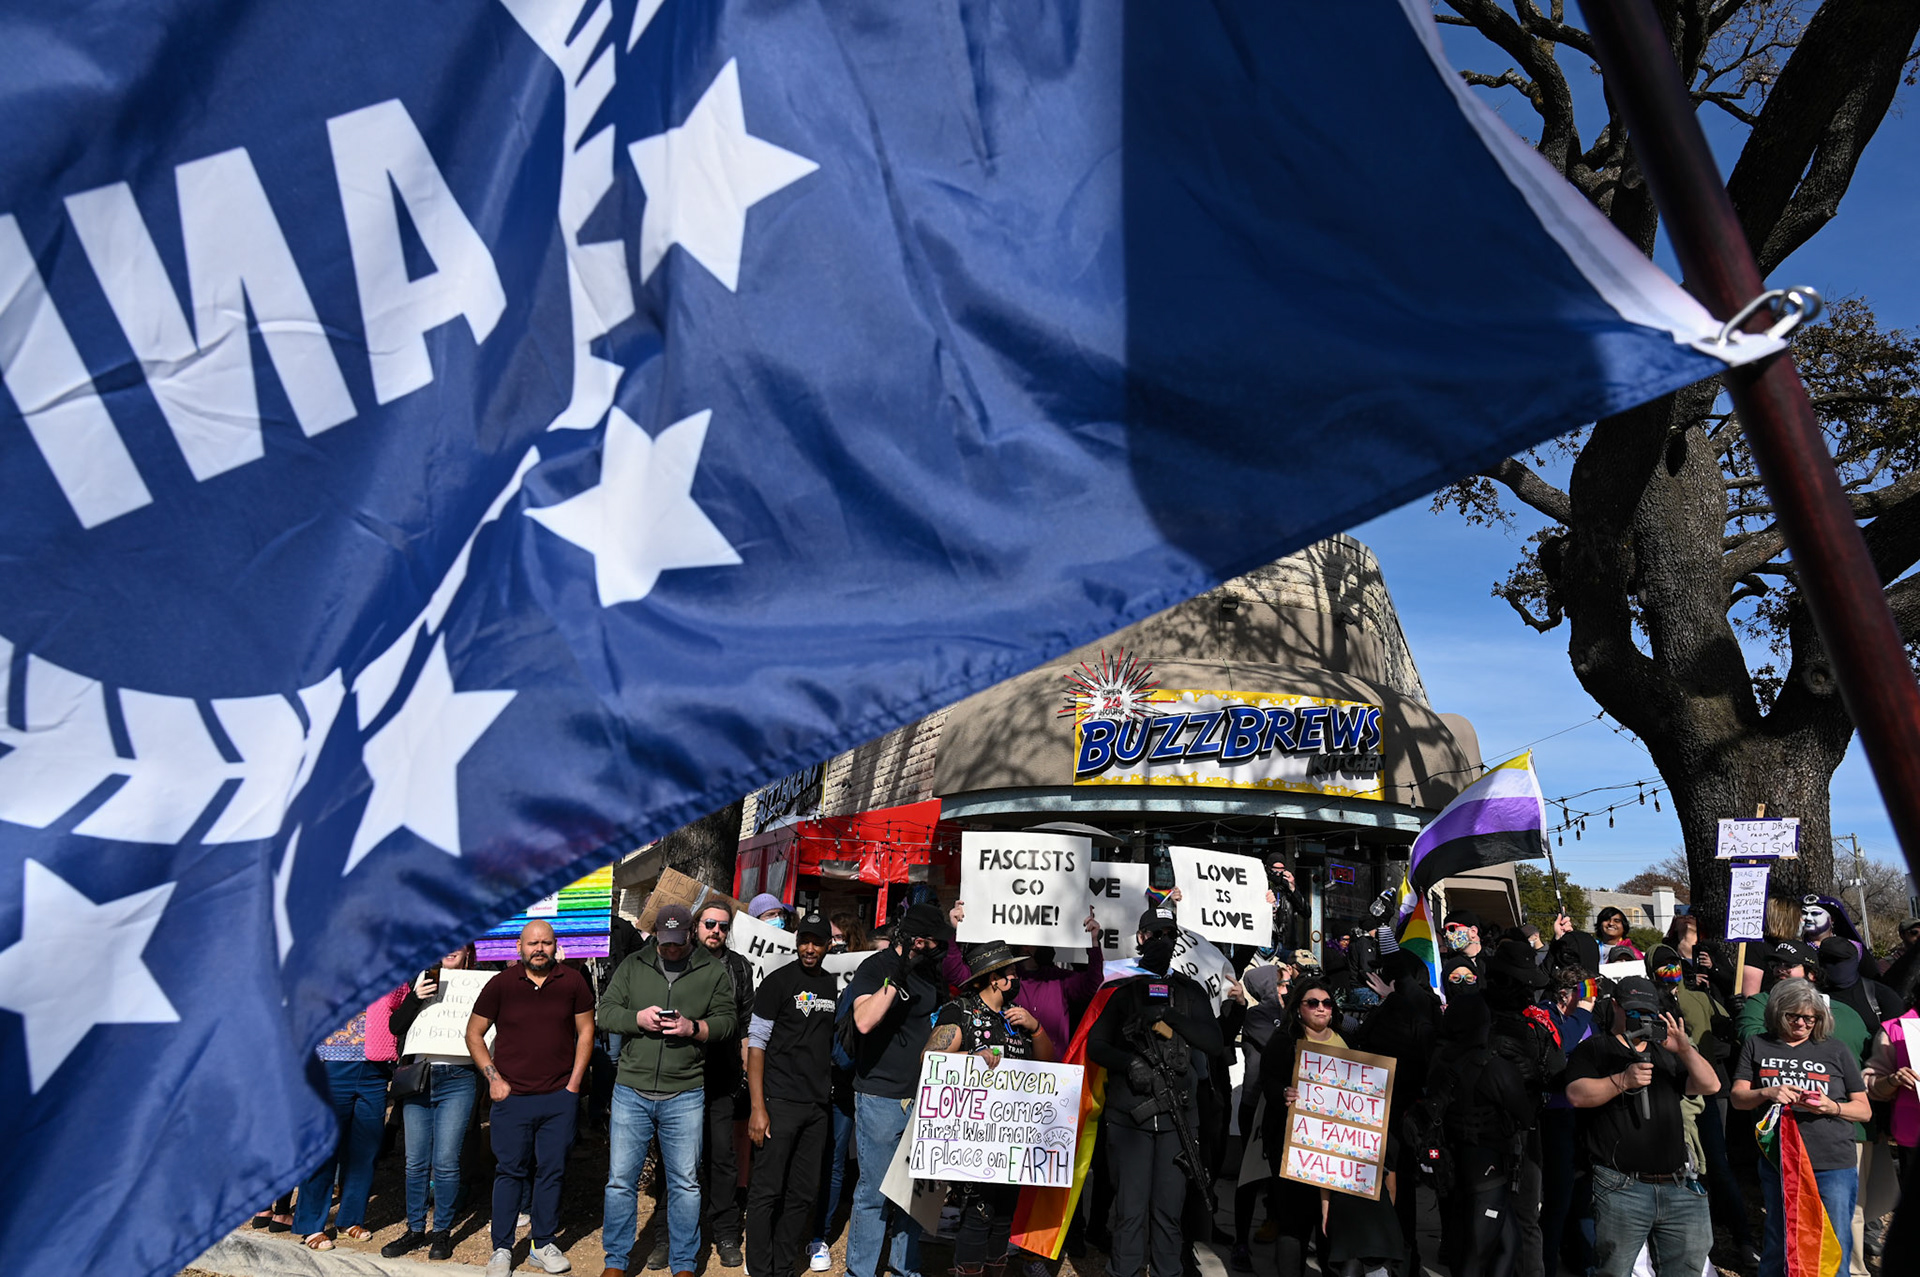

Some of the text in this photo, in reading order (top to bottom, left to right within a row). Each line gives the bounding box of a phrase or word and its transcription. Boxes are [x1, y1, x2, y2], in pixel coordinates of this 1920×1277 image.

[1103, 696, 1122, 709] 24
[1076, 705, 1383, 776] BUZZBREWS
[1306, 753, 1385, 776] KITCHEN
[1723, 822, 1795, 831] PROTECT DRAG
[1720, 841, 1795, 854] FASCISM
[979, 849, 1075, 872] FASCISTS
[1196, 862, 1248, 886] LOVE
[1012, 879, 1045, 896] GO
[1216, 888, 1231, 903] IS
[992, 903, 1060, 926] HOME!
[1201, 907, 1254, 931] LOVE
[1730, 921, 1761, 936] KIDS
[1007, 1045, 1024, 1054] TRAN
[925, 1054, 1059, 1097] In heaven,
[1304, 1052, 1374, 1085] HATE
[1761, 1058, 1826, 1074] LET'S GO
[1761, 1077, 1829, 1096] DARWIN
[919, 1086, 1058, 1125] LOVE comes
[1305, 1083, 1380, 1116] IS NOT
[917, 1118, 961, 1141] First
[999, 1125, 1042, 1144] make
[1295, 1117, 1381, 1151] A FAMILY
[911, 1141, 1070, 1185] A place on EARTH
[1297, 1150, 1367, 1183] VALUE
